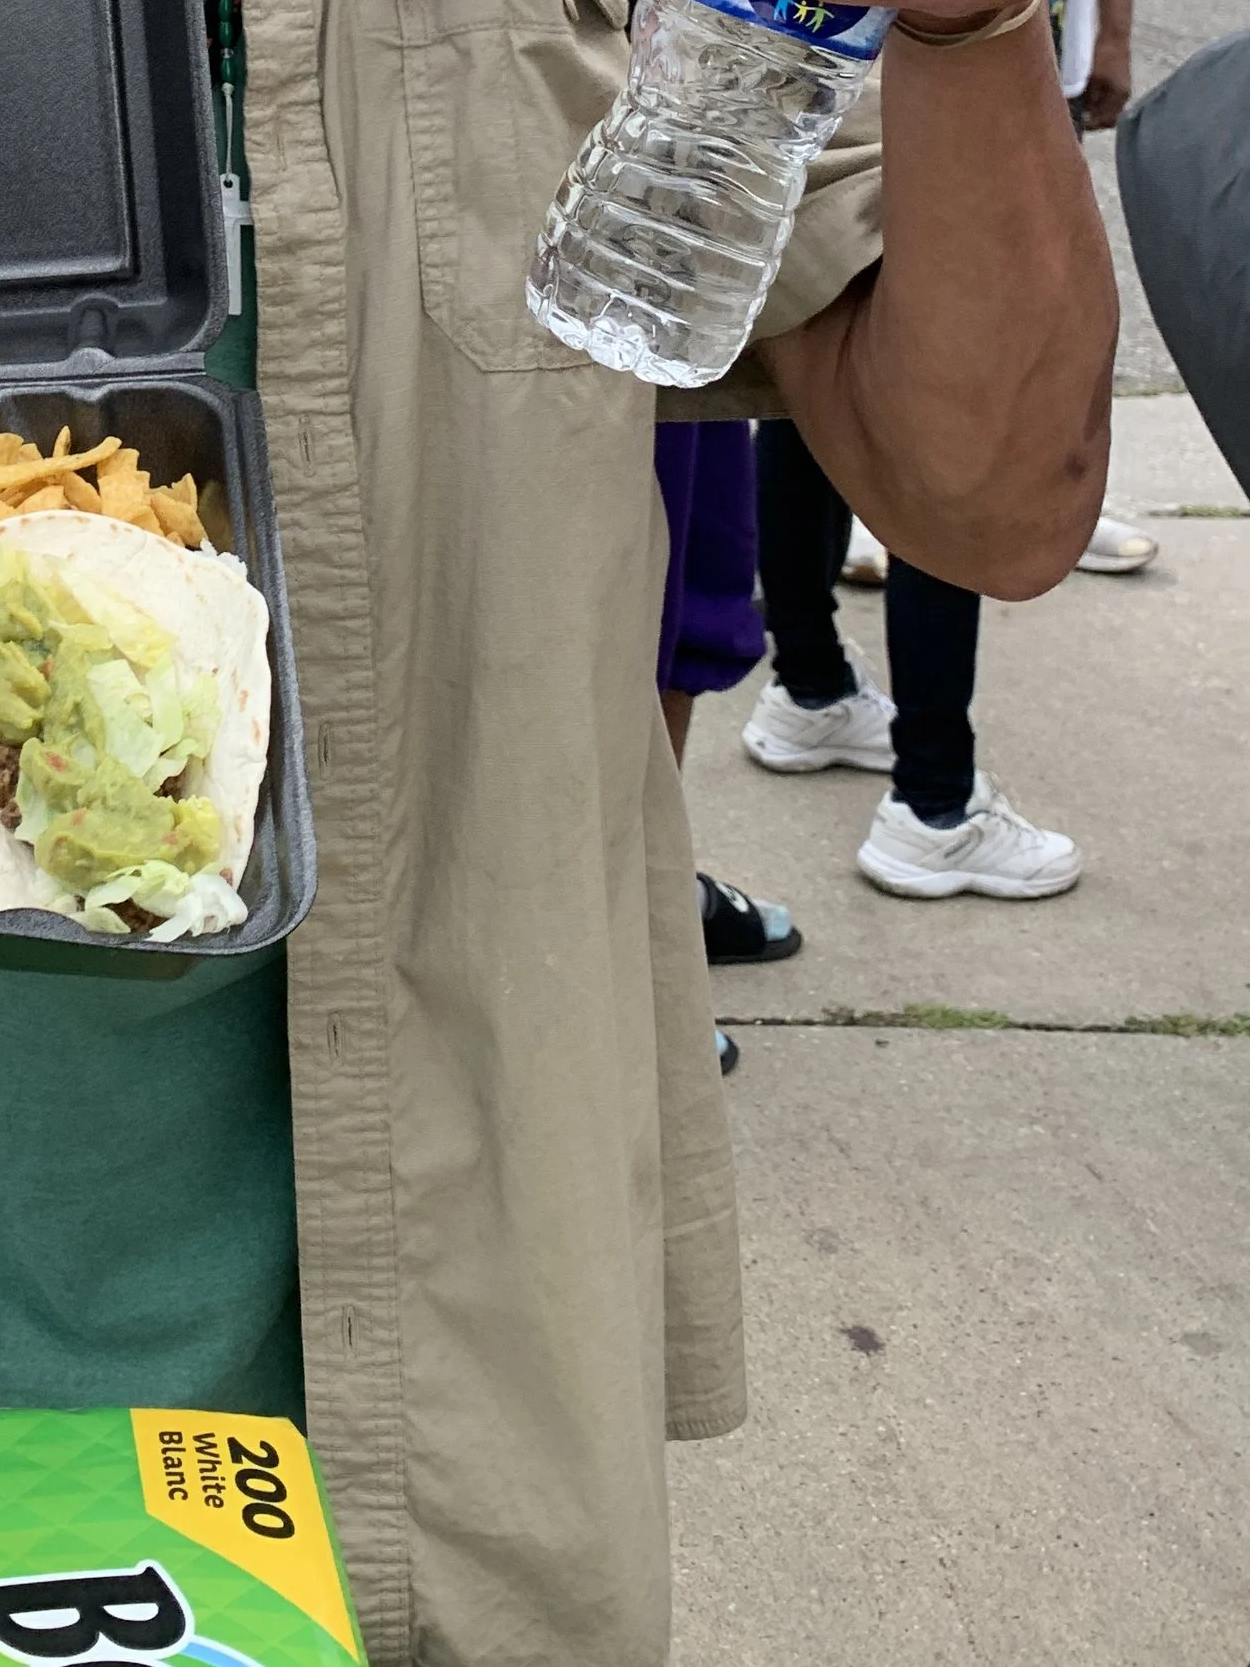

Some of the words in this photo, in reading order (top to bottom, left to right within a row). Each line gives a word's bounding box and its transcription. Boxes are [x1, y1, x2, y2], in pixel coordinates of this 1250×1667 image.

[158, 1431, 189, 1501] Blanc
[192, 1432, 226, 1509] White
[227, 1436, 296, 1540] 200
